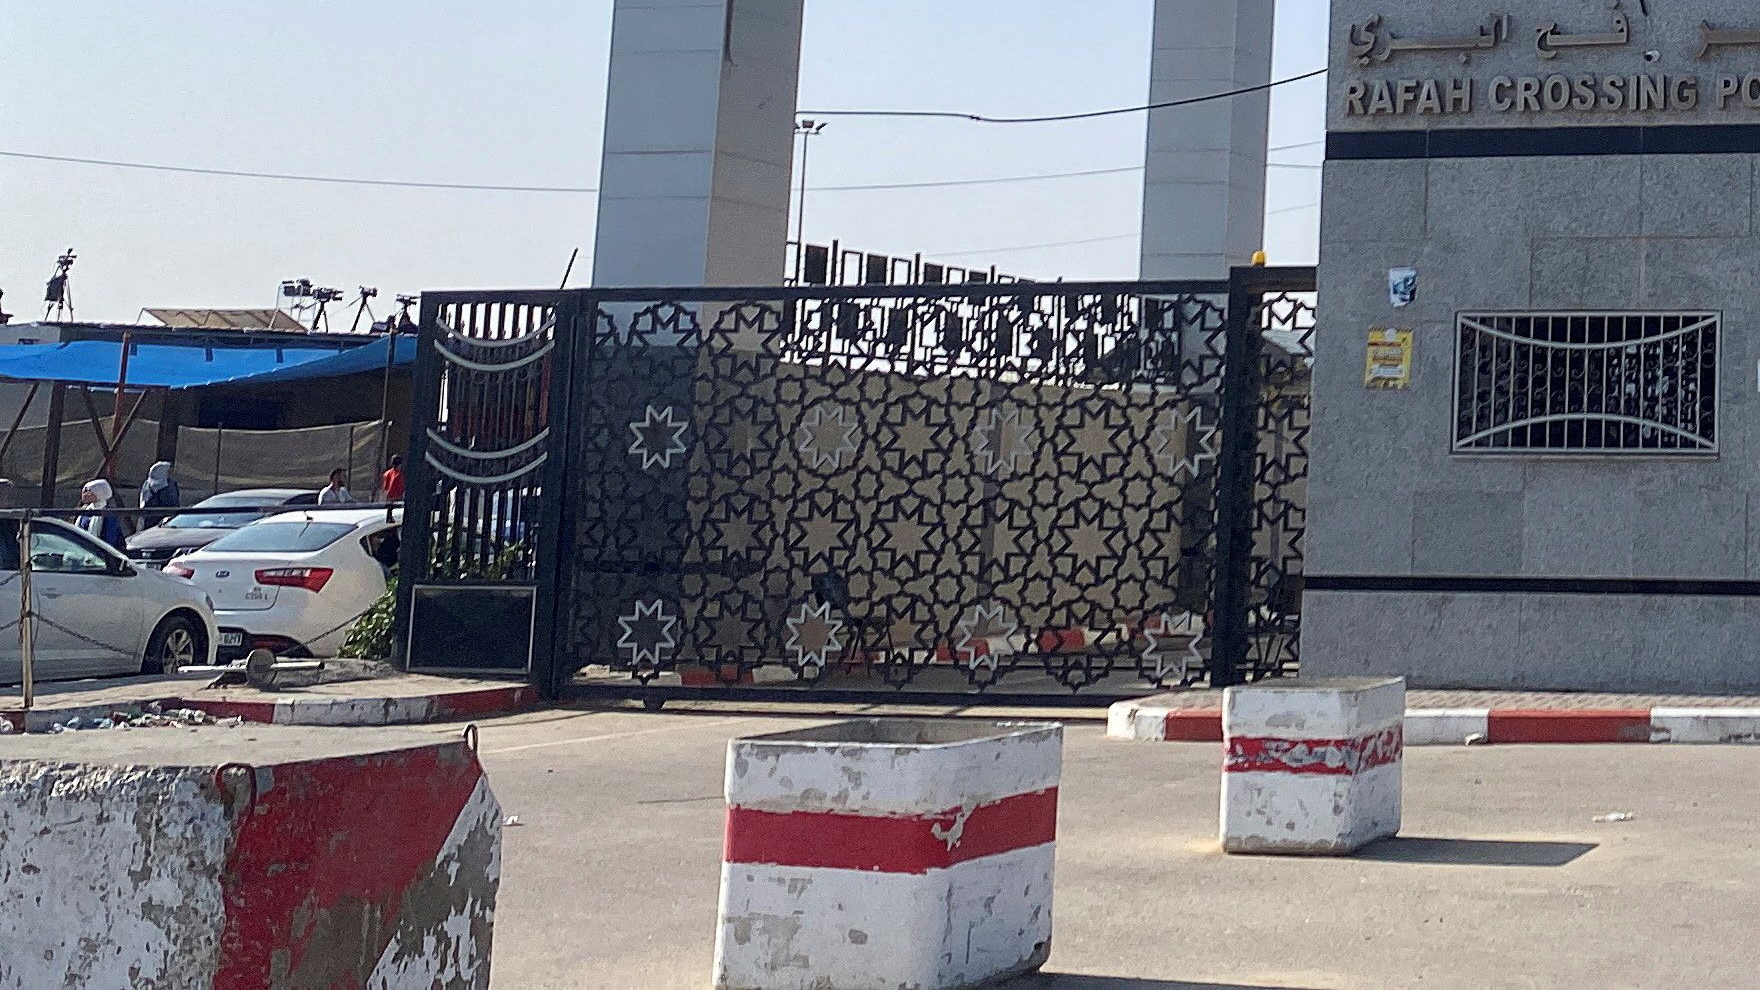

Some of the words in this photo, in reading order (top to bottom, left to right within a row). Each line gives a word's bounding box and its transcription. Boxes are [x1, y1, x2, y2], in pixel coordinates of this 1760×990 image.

[1347, 13, 1510, 66] البري
[1346, 76, 1473, 116] RAFAH
[1488, 72, 1698, 112] CROSSING
